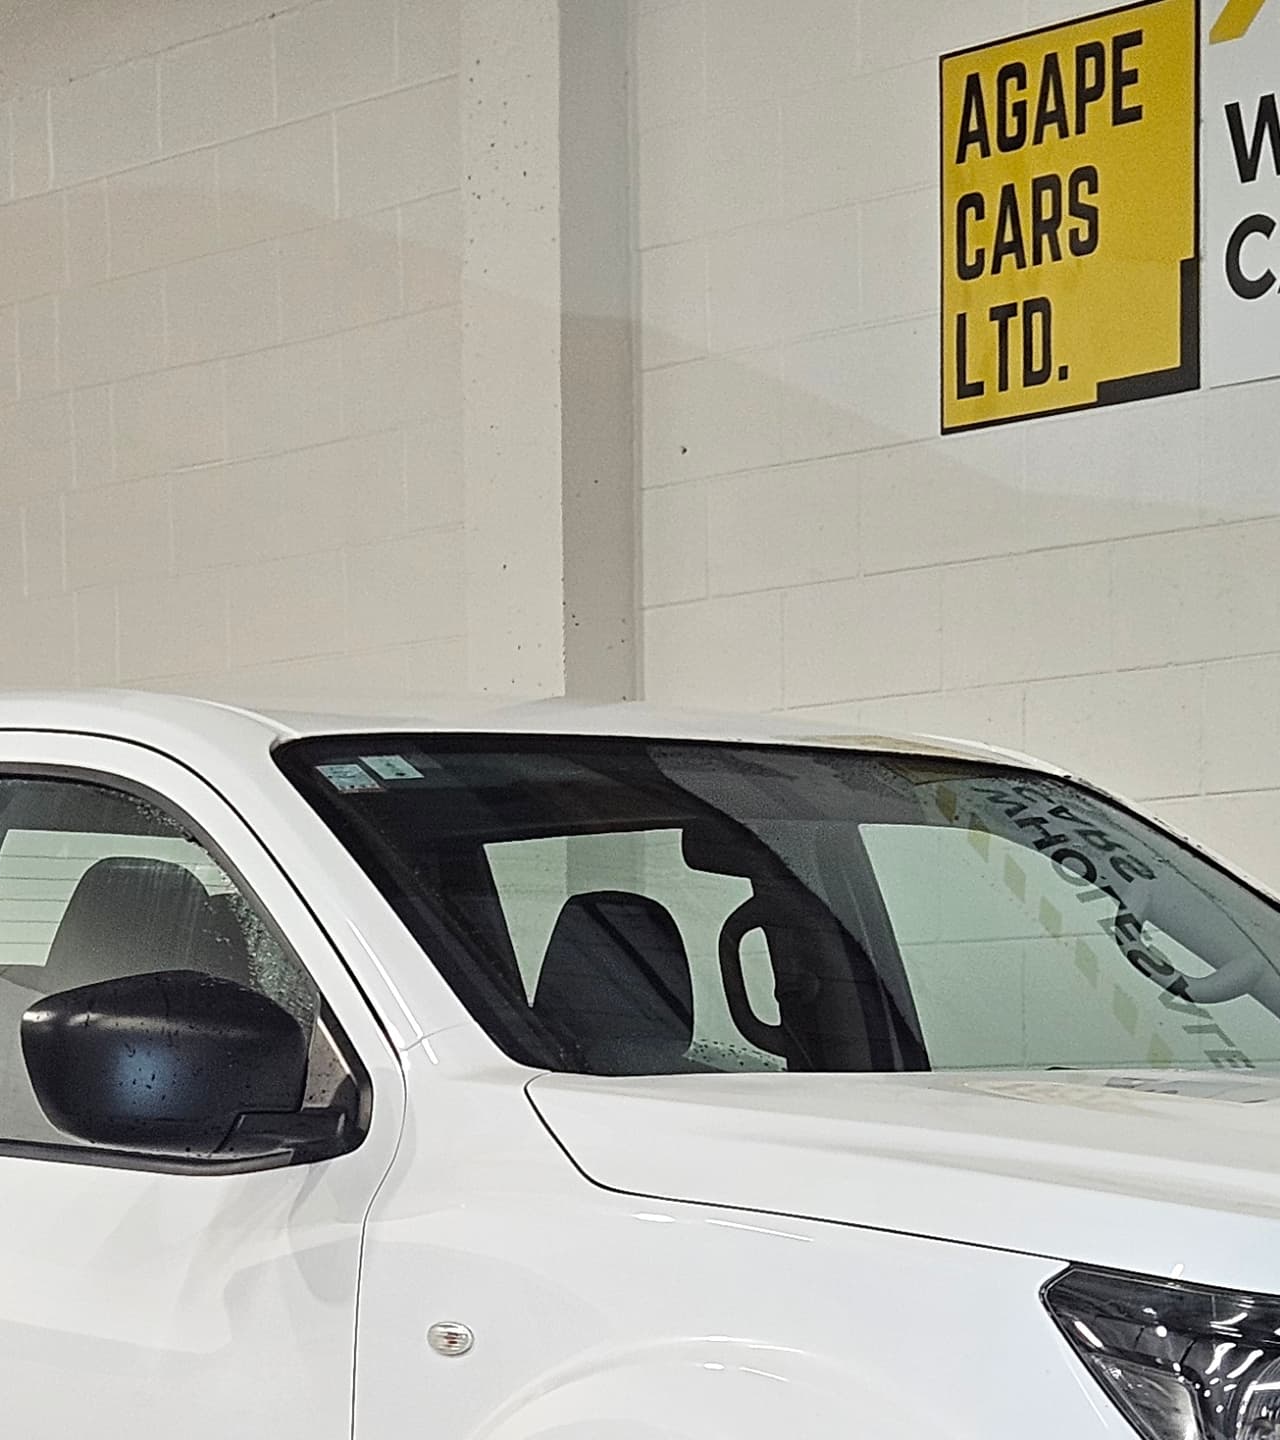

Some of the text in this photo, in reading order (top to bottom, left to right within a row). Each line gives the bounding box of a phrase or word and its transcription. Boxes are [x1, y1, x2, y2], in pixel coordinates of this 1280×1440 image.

[955, 30, 1143, 164] AGAPE
[955, 165, 1099, 281] CARS
[956, 296, 1068, 399] LTD.
